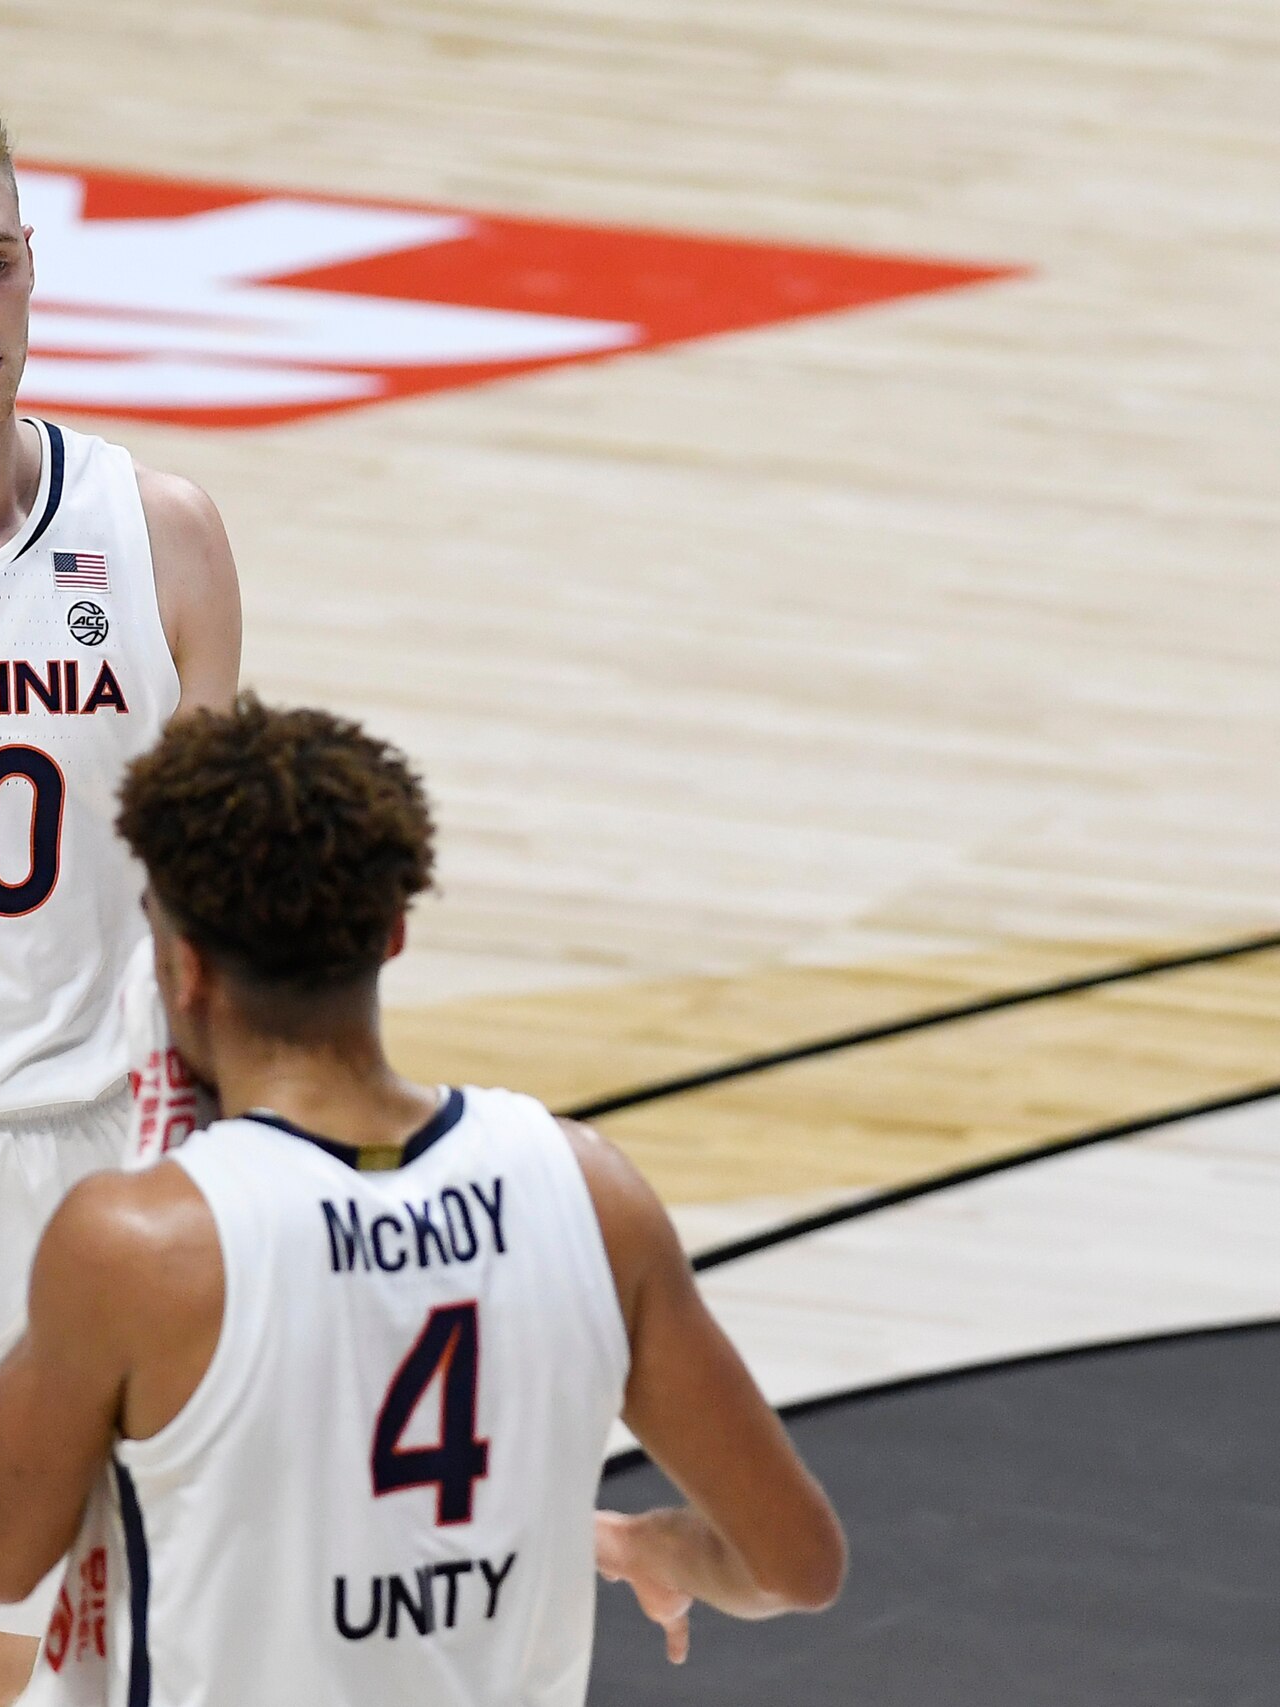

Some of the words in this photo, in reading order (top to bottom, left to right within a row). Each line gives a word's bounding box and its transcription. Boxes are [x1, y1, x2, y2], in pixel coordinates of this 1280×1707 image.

[72, 615, 106, 627] ACC
[320, 1177, 507, 1272] McKOY
[370, 1298, 490, 1527] 4
[333, 1552, 517, 1641] UNTY
